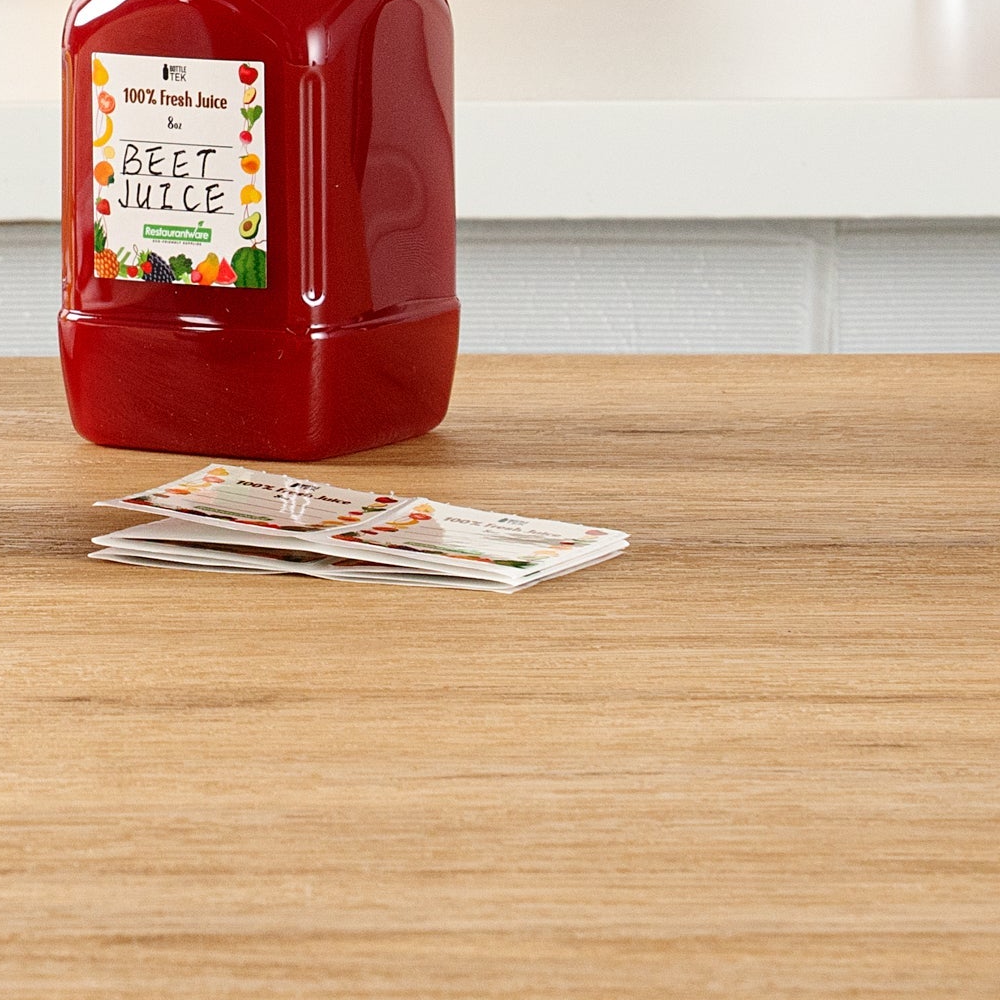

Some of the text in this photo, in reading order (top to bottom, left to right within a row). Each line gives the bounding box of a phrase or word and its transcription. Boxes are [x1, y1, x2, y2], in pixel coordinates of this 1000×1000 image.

[169, 65, 187, 73] BOTTLE
[170, 73, 187, 82] TEK
[123, 87, 228, 109] 100% Fresh Juice
[167, 116, 182, 130] 8oz
[122, 144, 217, 178] BEET
[118, 179, 225, 214] JUICE
